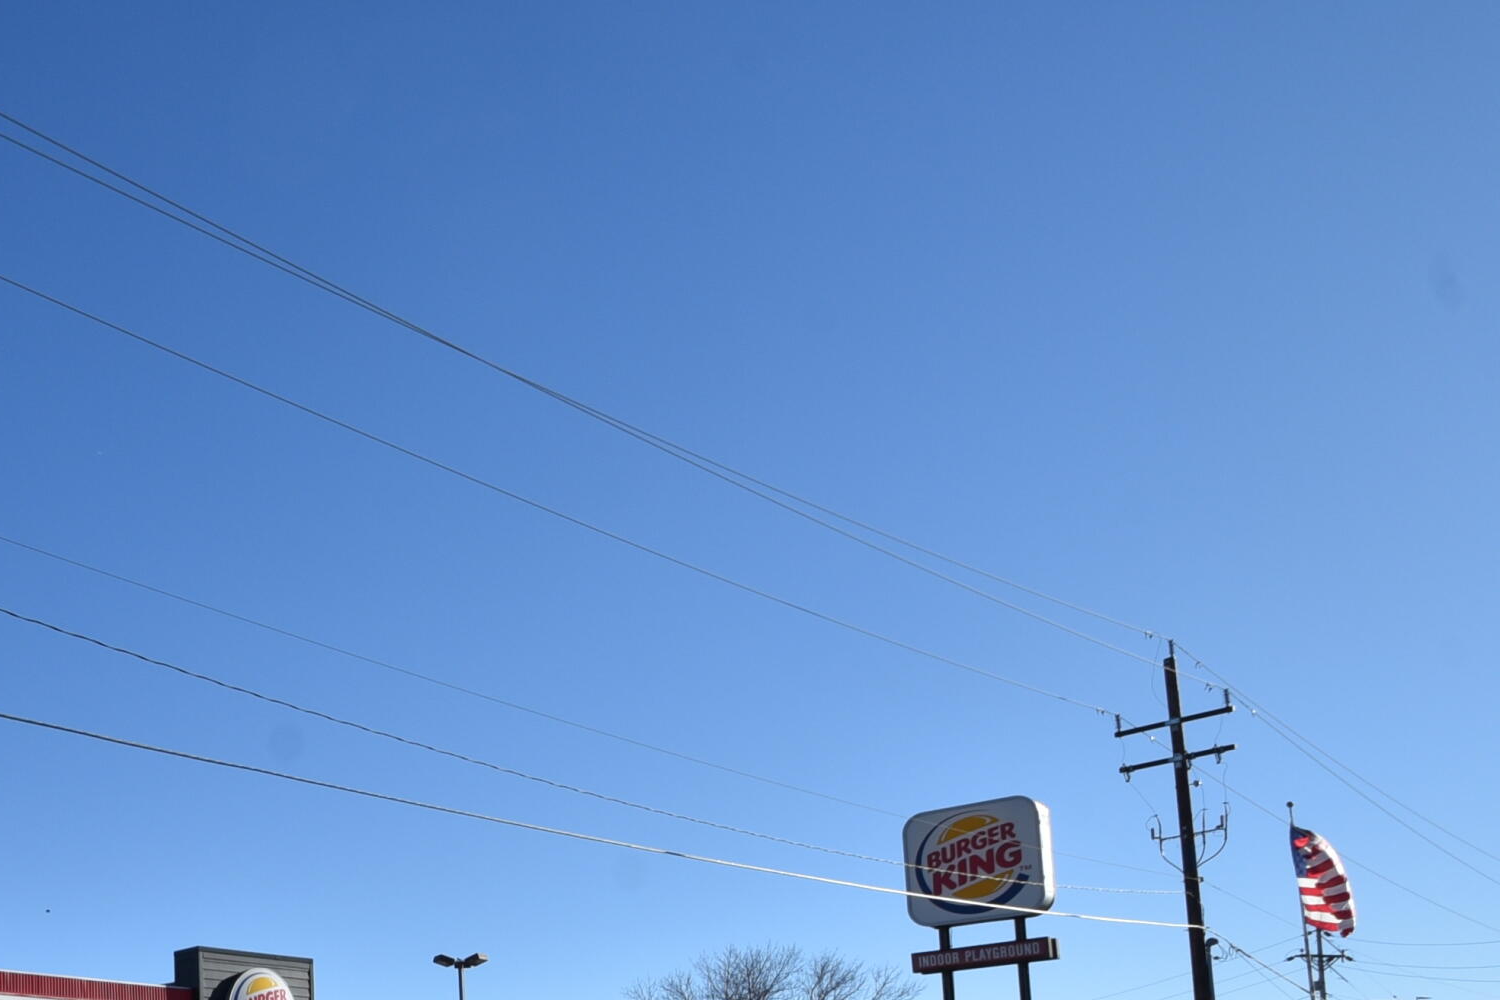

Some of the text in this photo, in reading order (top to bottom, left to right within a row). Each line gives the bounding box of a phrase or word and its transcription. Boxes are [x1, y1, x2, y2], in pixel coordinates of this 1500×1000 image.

[927, 822, 1016, 872] BURGER
[933, 841, 1022, 896] KING
[918, 942, 1040, 968] INDOOR PLAYGROUND
